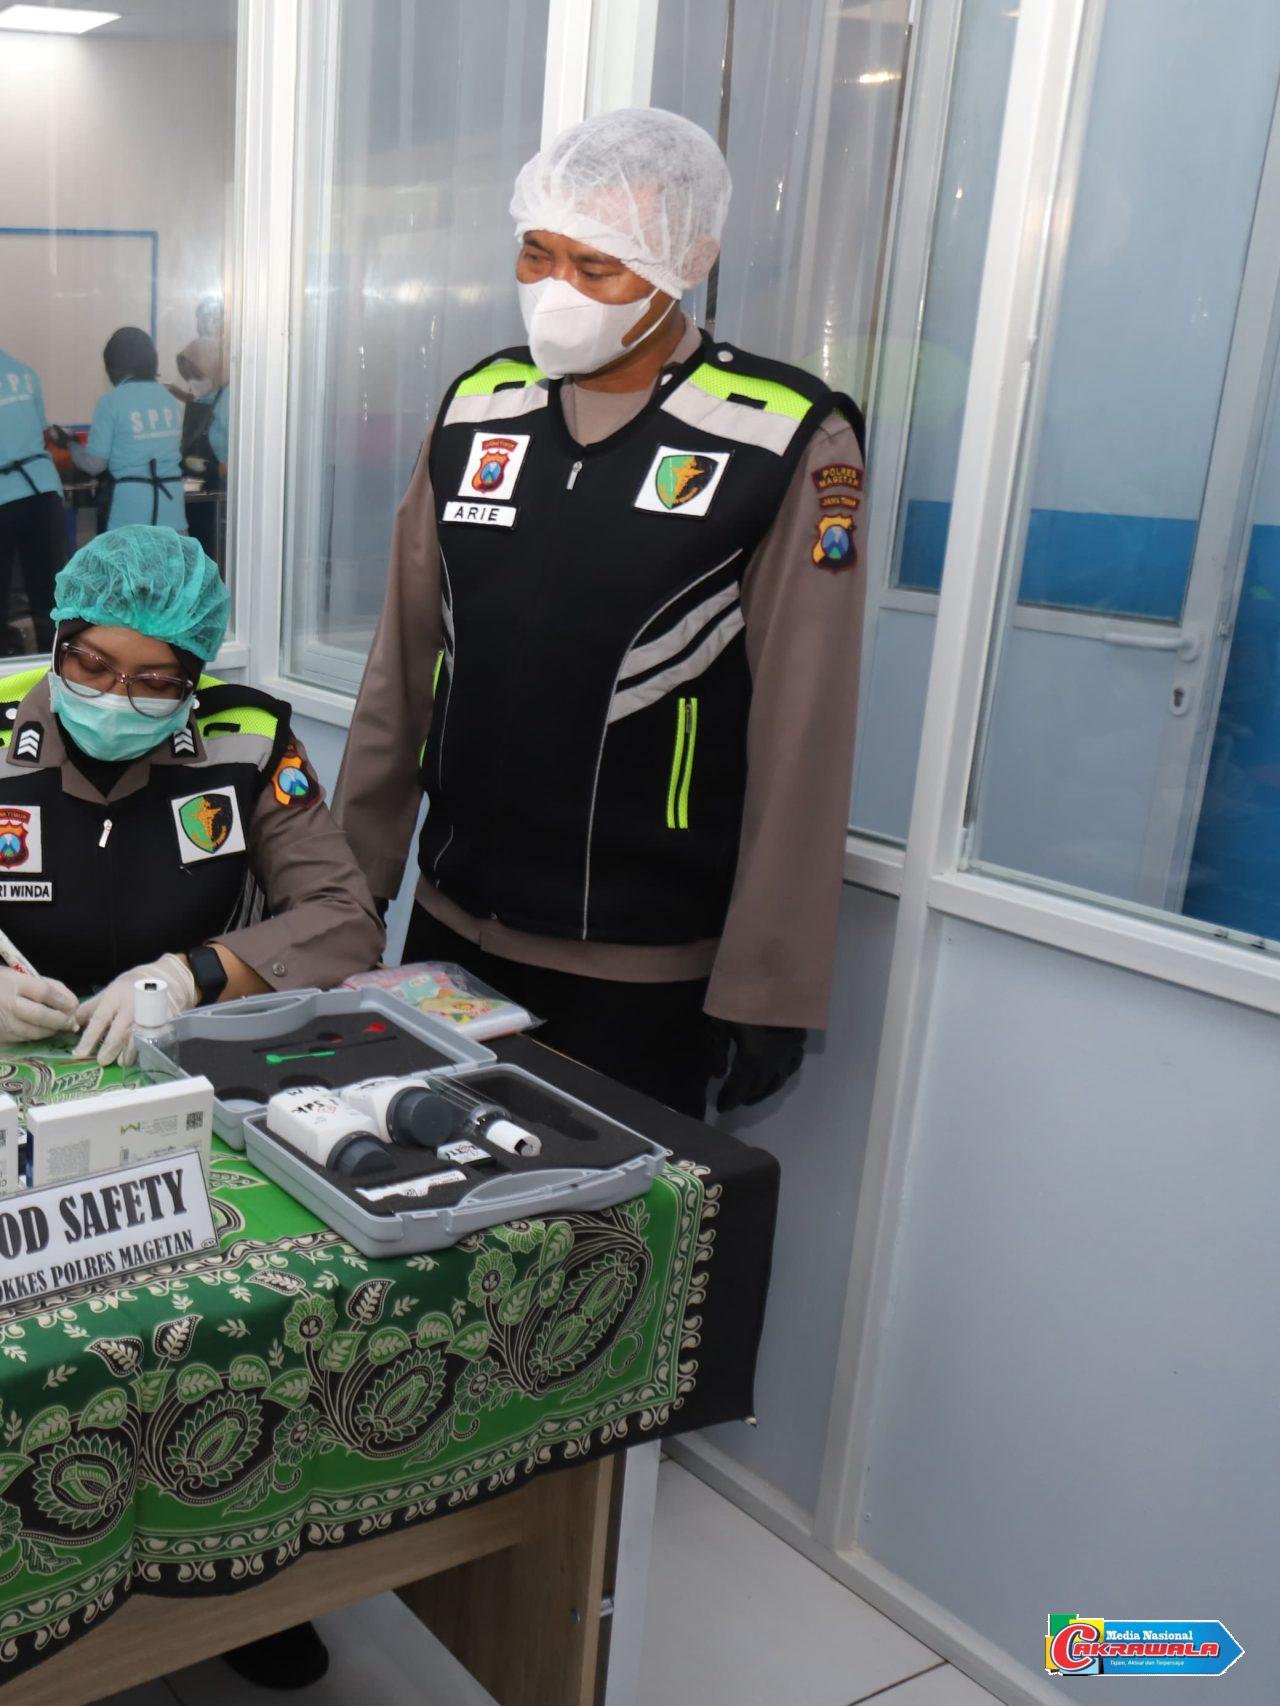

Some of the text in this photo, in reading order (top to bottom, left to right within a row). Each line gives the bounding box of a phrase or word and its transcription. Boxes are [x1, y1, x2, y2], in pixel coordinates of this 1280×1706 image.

[823, 467, 857, 479] POLRES
[454, 506, 500, 522] ARIE
[9, 884, 50, 899] WINDA
[59, 1168, 187, 1244] SAFETY
[50, 1249, 118, 1287] POLRES
[119, 1229, 194, 1269] MAGETAN
